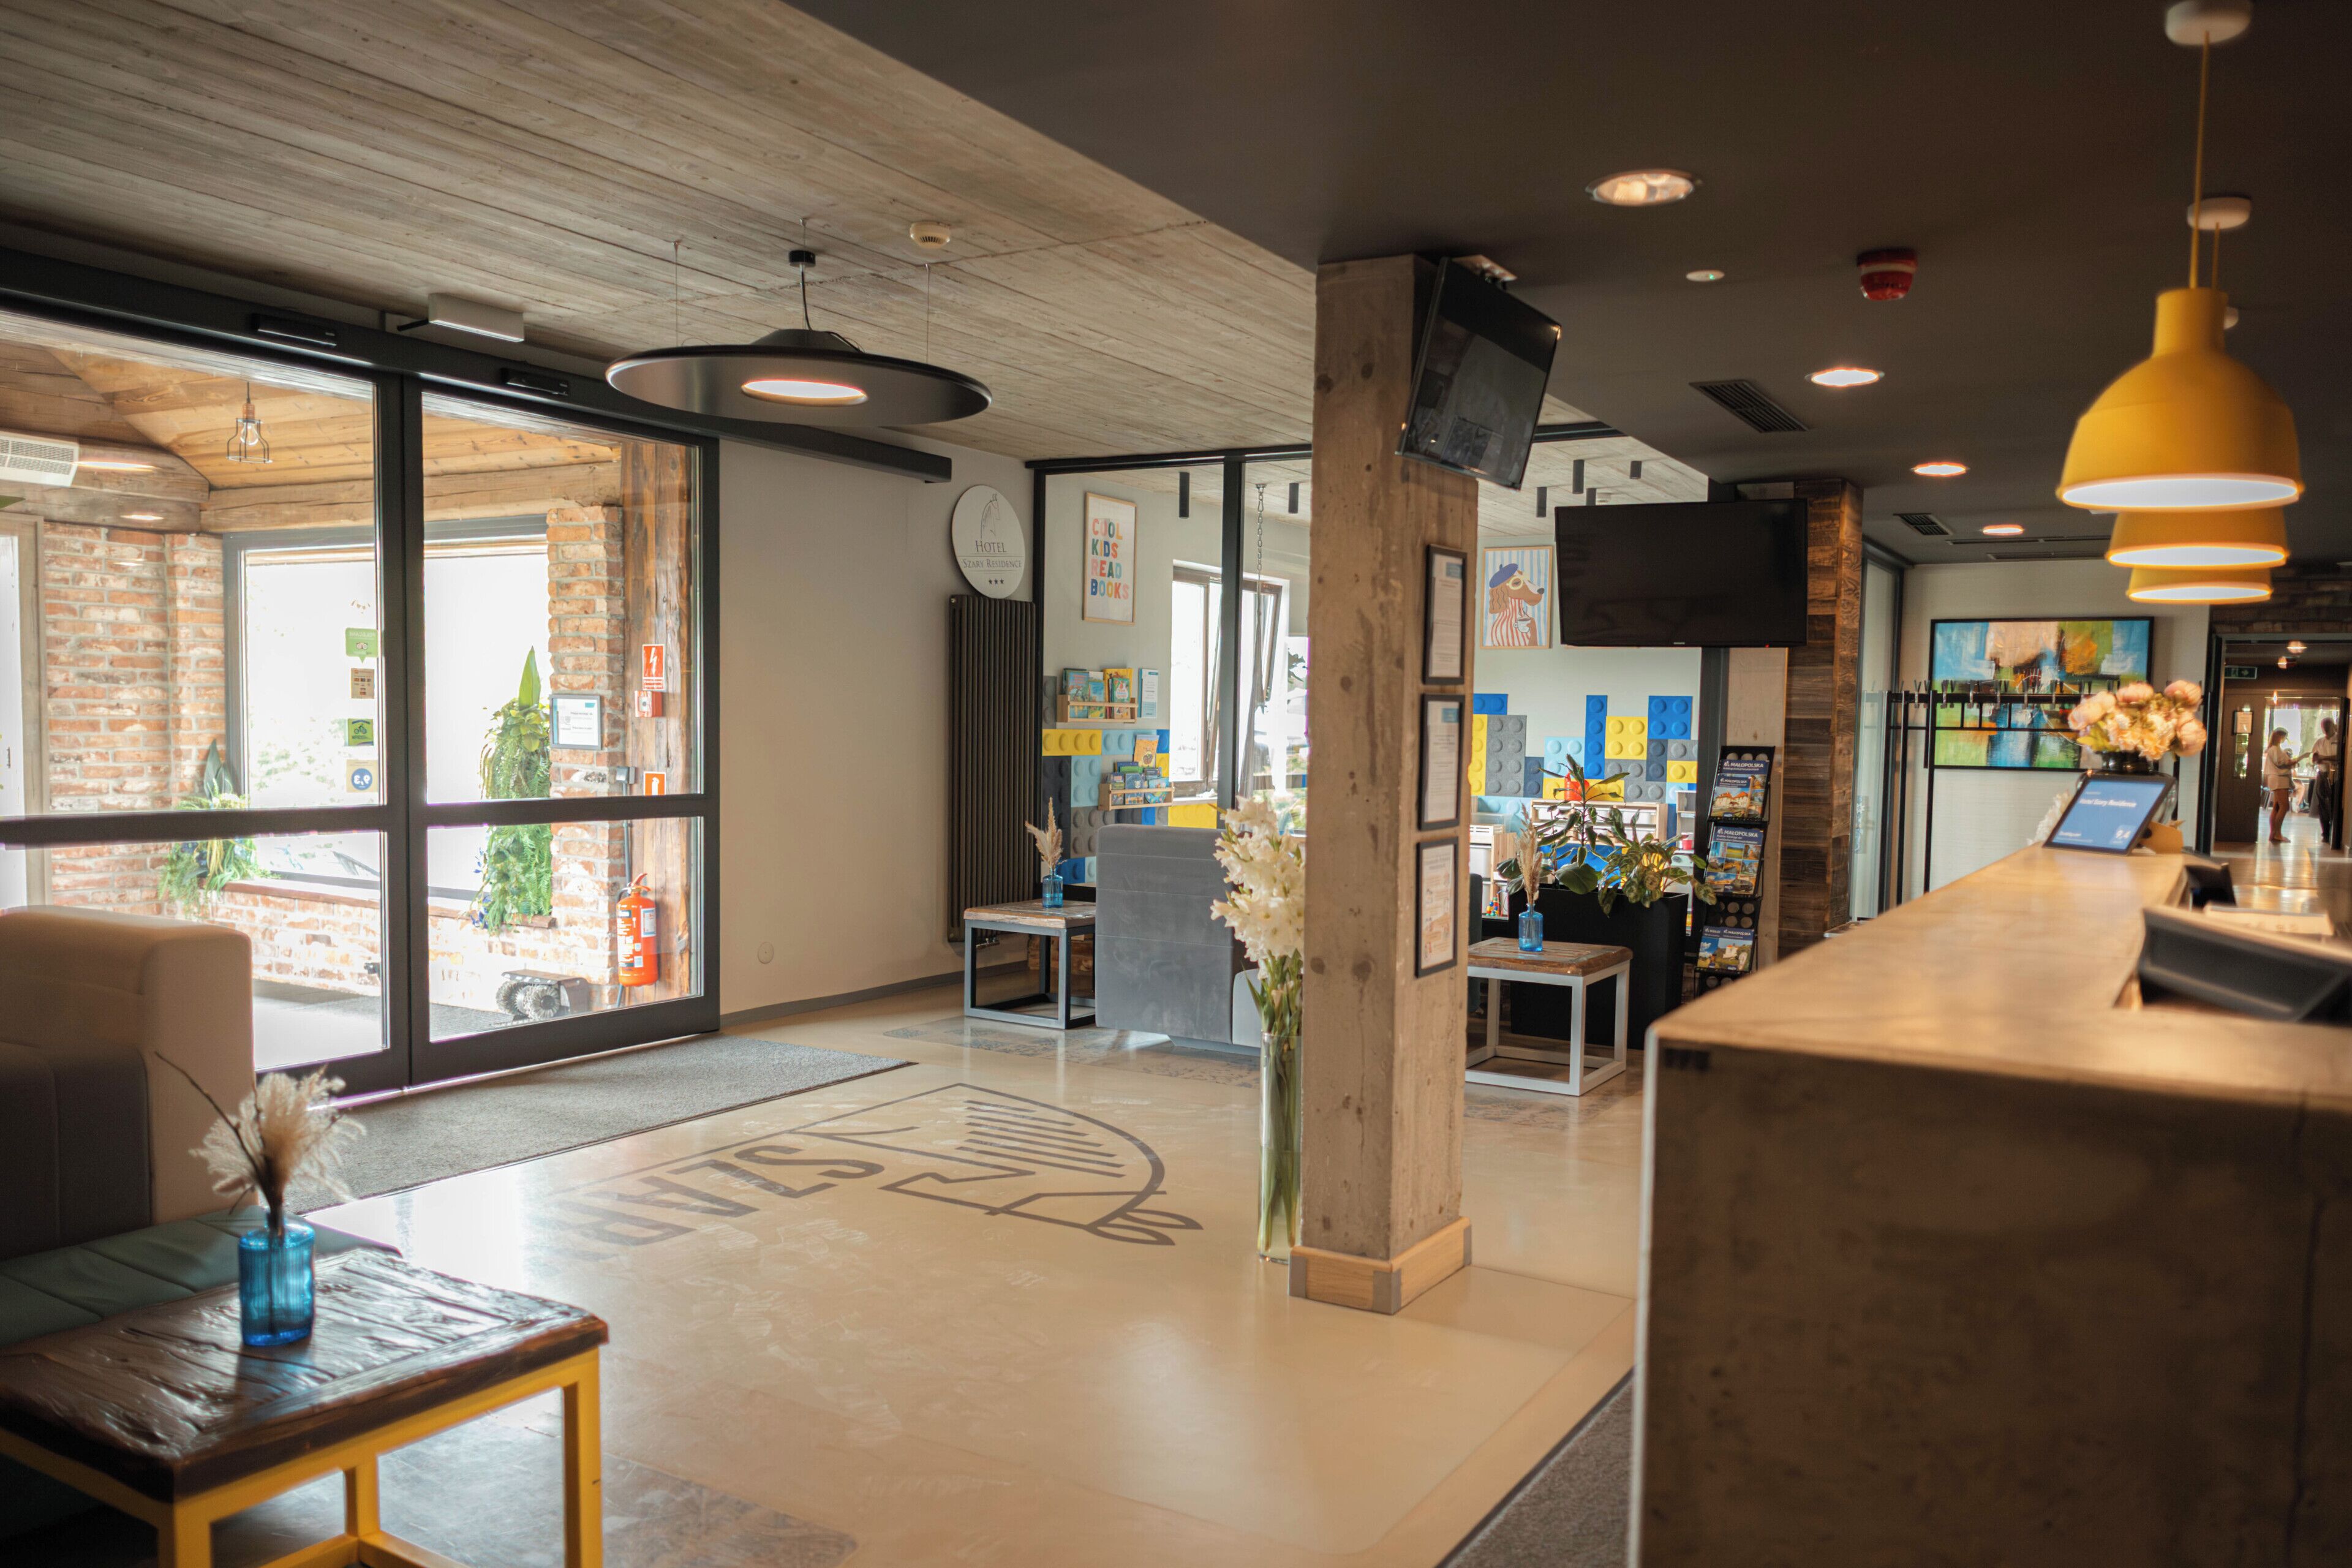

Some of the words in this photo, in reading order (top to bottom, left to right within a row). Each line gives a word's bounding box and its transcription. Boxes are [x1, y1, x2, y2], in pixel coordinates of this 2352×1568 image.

[1092, 518, 1123, 540] COOL
[975, 540, 1007, 553] HOTEL
[1091, 538, 1118, 559] KIDS
[1091, 558, 1122, 579] READ
[1090, 578, 1129, 600] BOOKS
